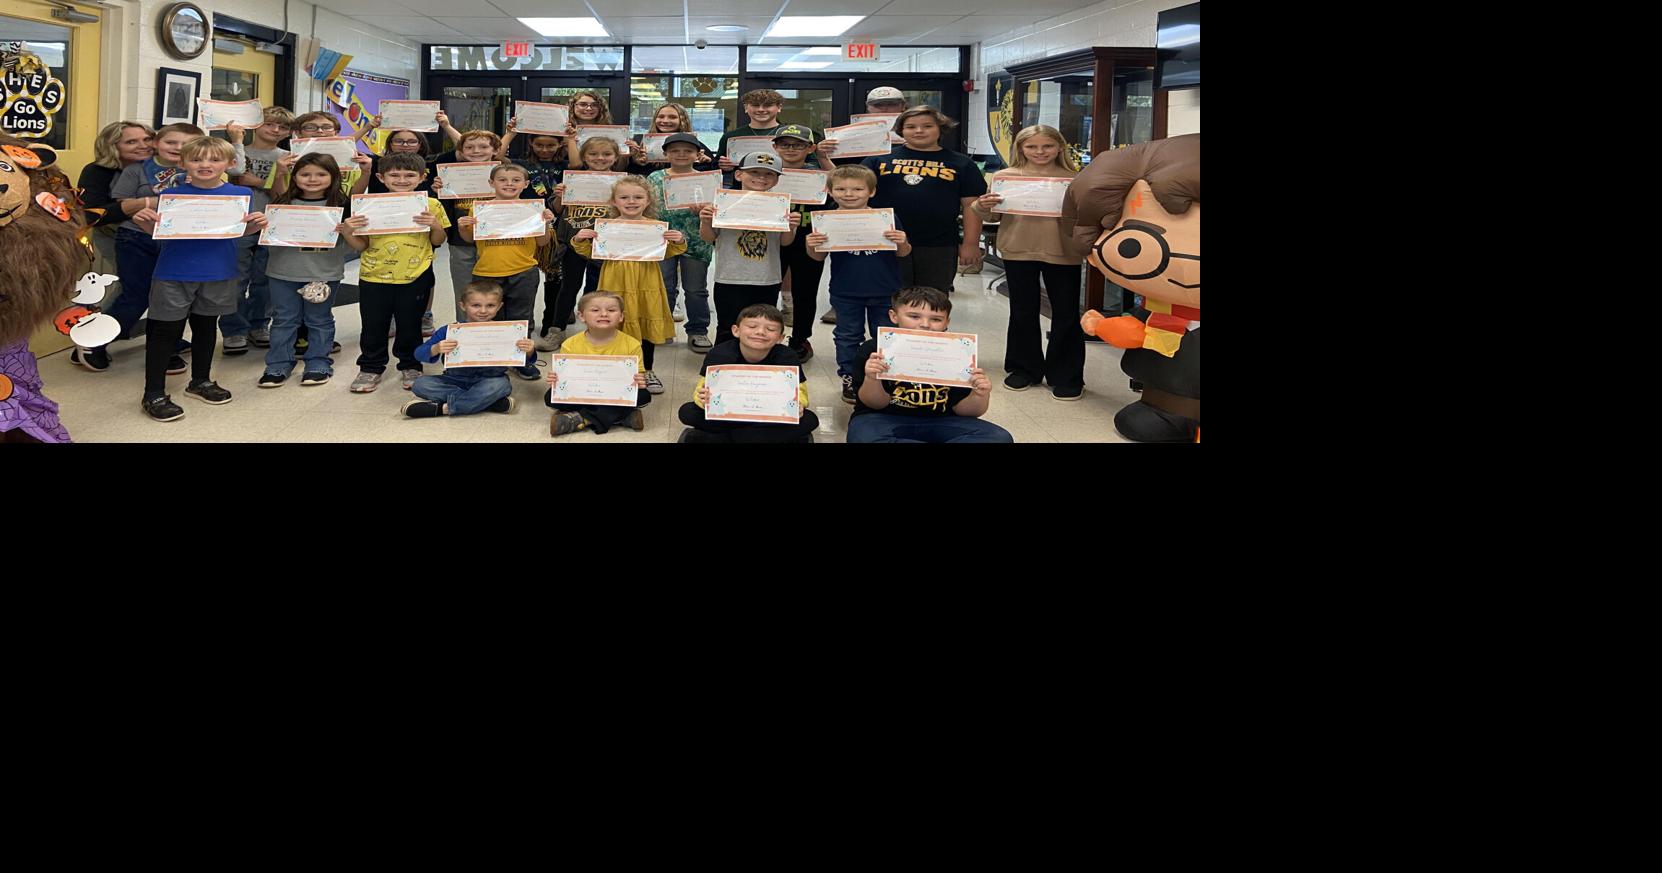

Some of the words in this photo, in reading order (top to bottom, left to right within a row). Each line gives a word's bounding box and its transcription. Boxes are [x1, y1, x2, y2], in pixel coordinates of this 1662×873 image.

[505, 41, 529, 57] EXIT
[848, 44, 875, 58] EXIT
[14, 101, 36, 115] Go
[3, 116, 45, 129] Lions
[879, 162, 957, 181] LIONS
